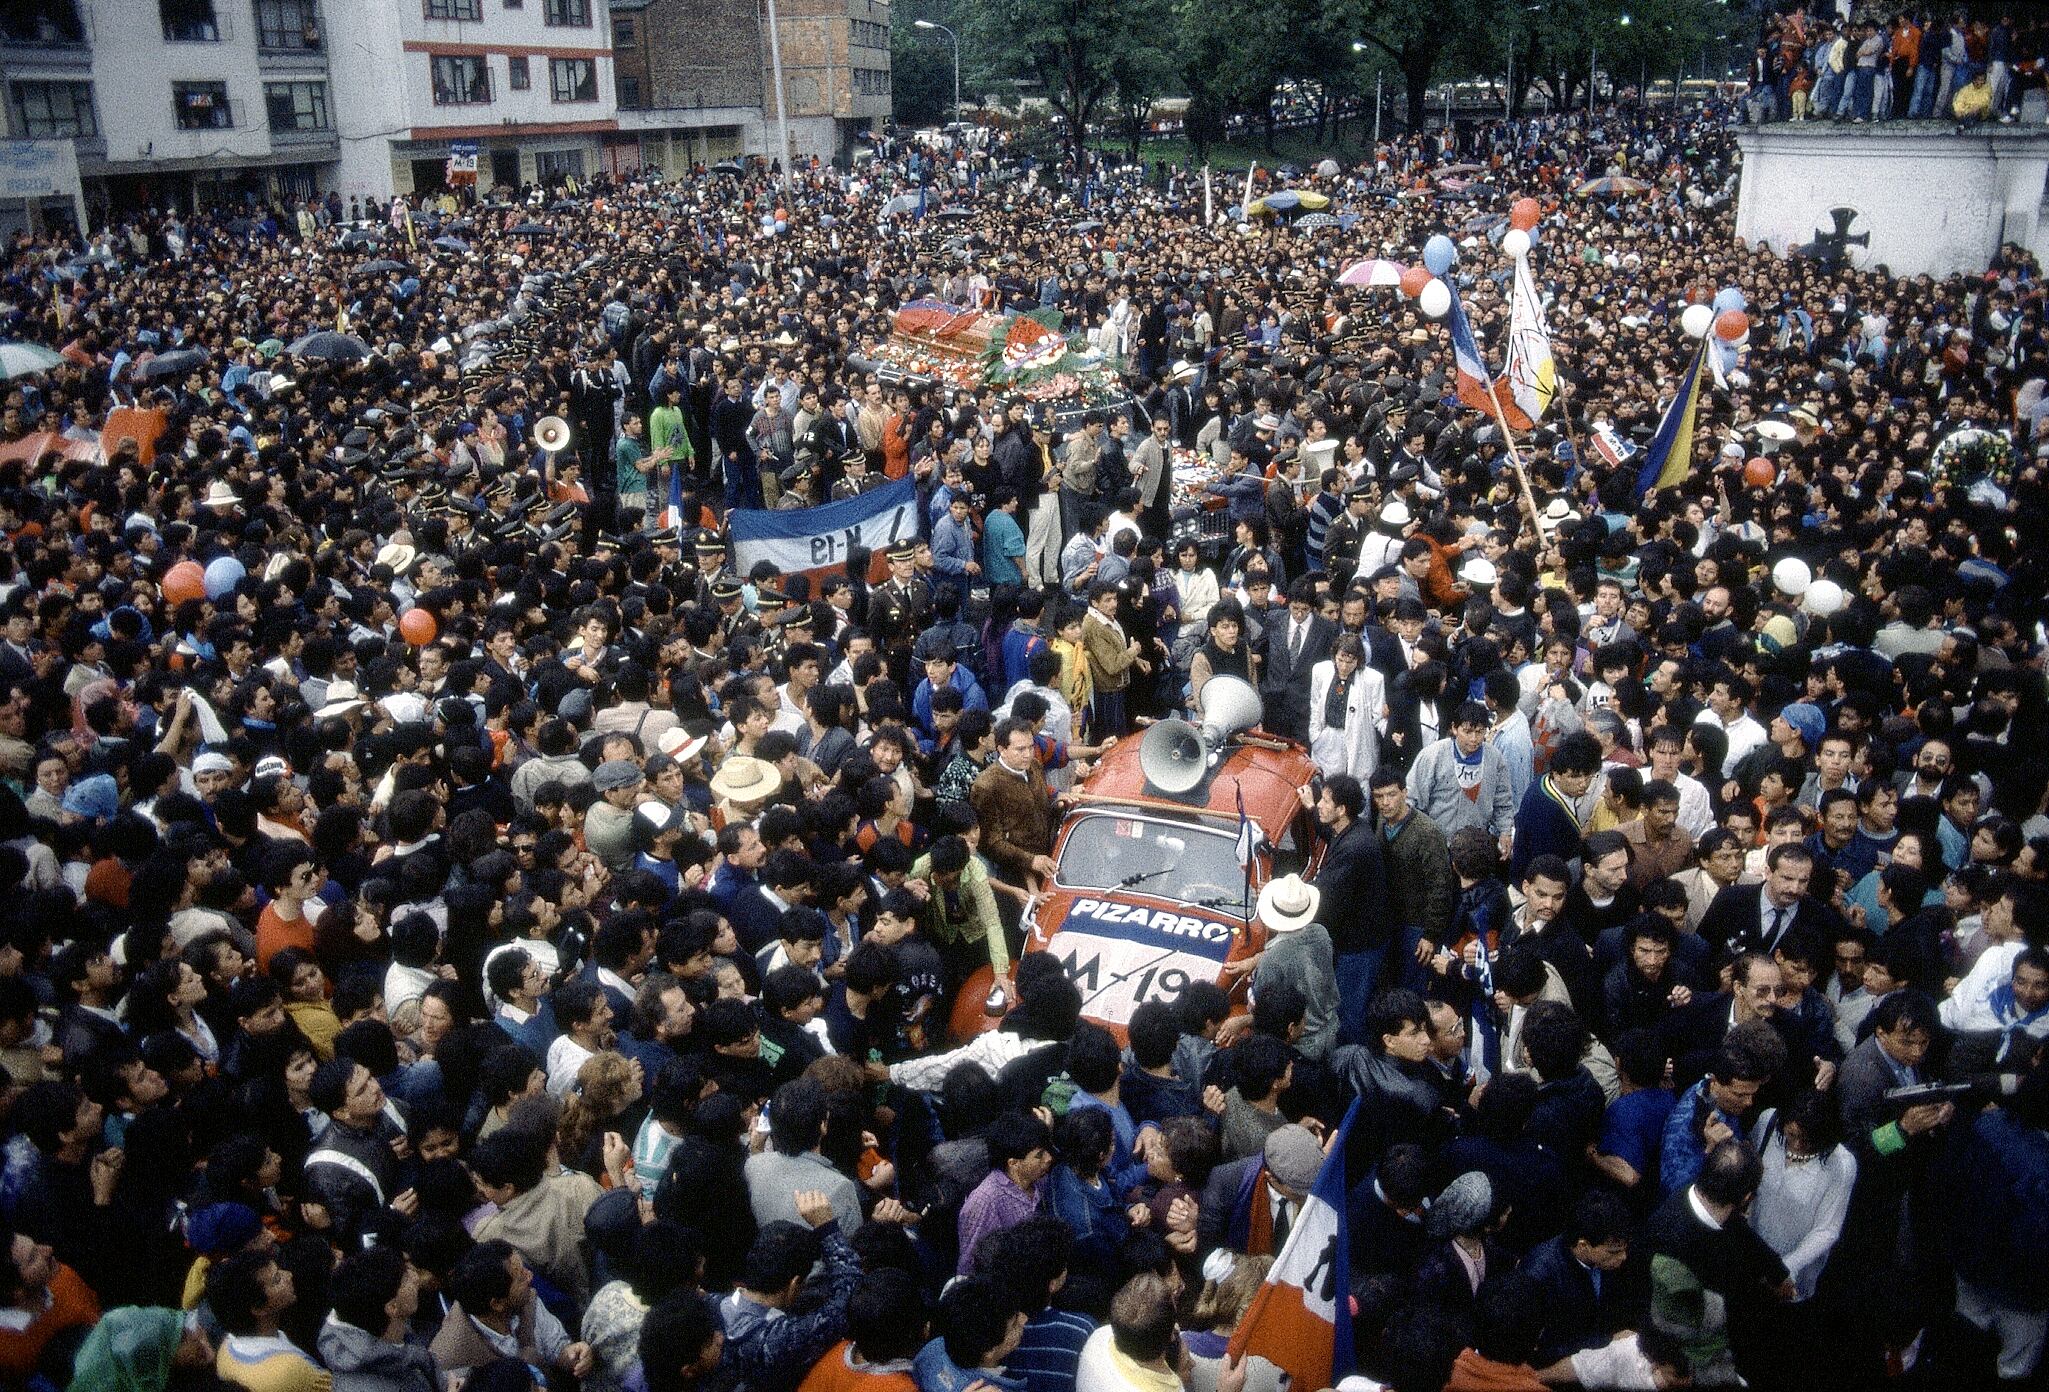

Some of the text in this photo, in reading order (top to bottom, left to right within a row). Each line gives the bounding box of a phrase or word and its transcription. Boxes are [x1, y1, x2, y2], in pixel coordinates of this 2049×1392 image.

[454, 158, 475, 168] M-19
[1070, 899, 1230, 943] PIZARRO
[1060, 948, 1191, 1004] M-19
